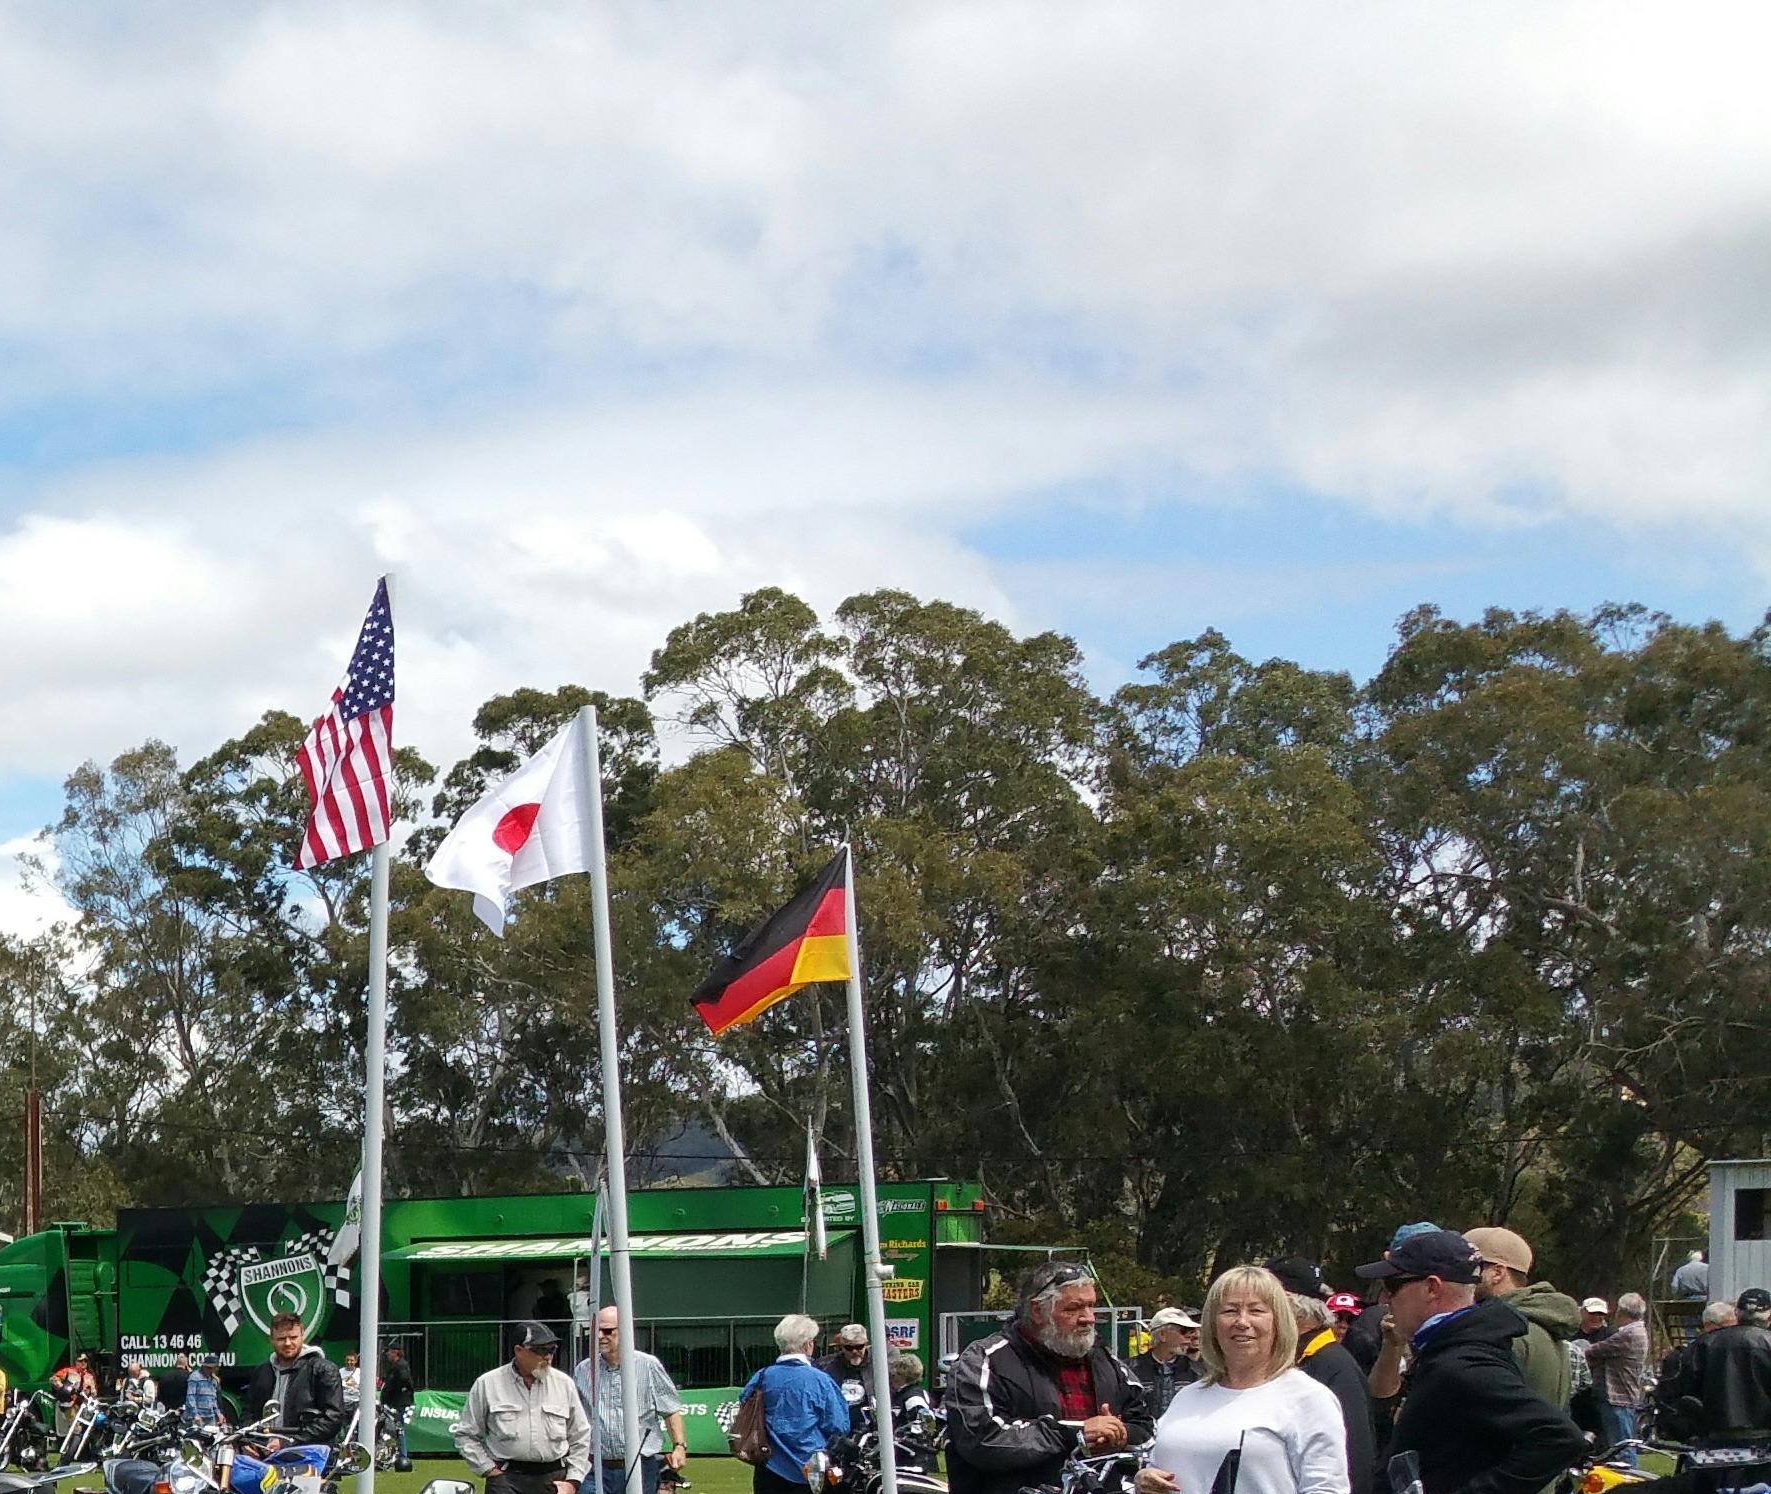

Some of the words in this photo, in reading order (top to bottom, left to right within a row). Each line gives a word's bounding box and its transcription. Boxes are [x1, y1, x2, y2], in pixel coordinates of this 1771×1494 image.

[889, 1239, 926, 1249] Richards
[243, 1256, 313, 1284] SHANNONS
[121, 1335, 149, 1350] CALL
[153, 1335, 167, 1349] 13
[169, 1334, 184, 1349] 46
[186, 1334, 202, 1348] 46
